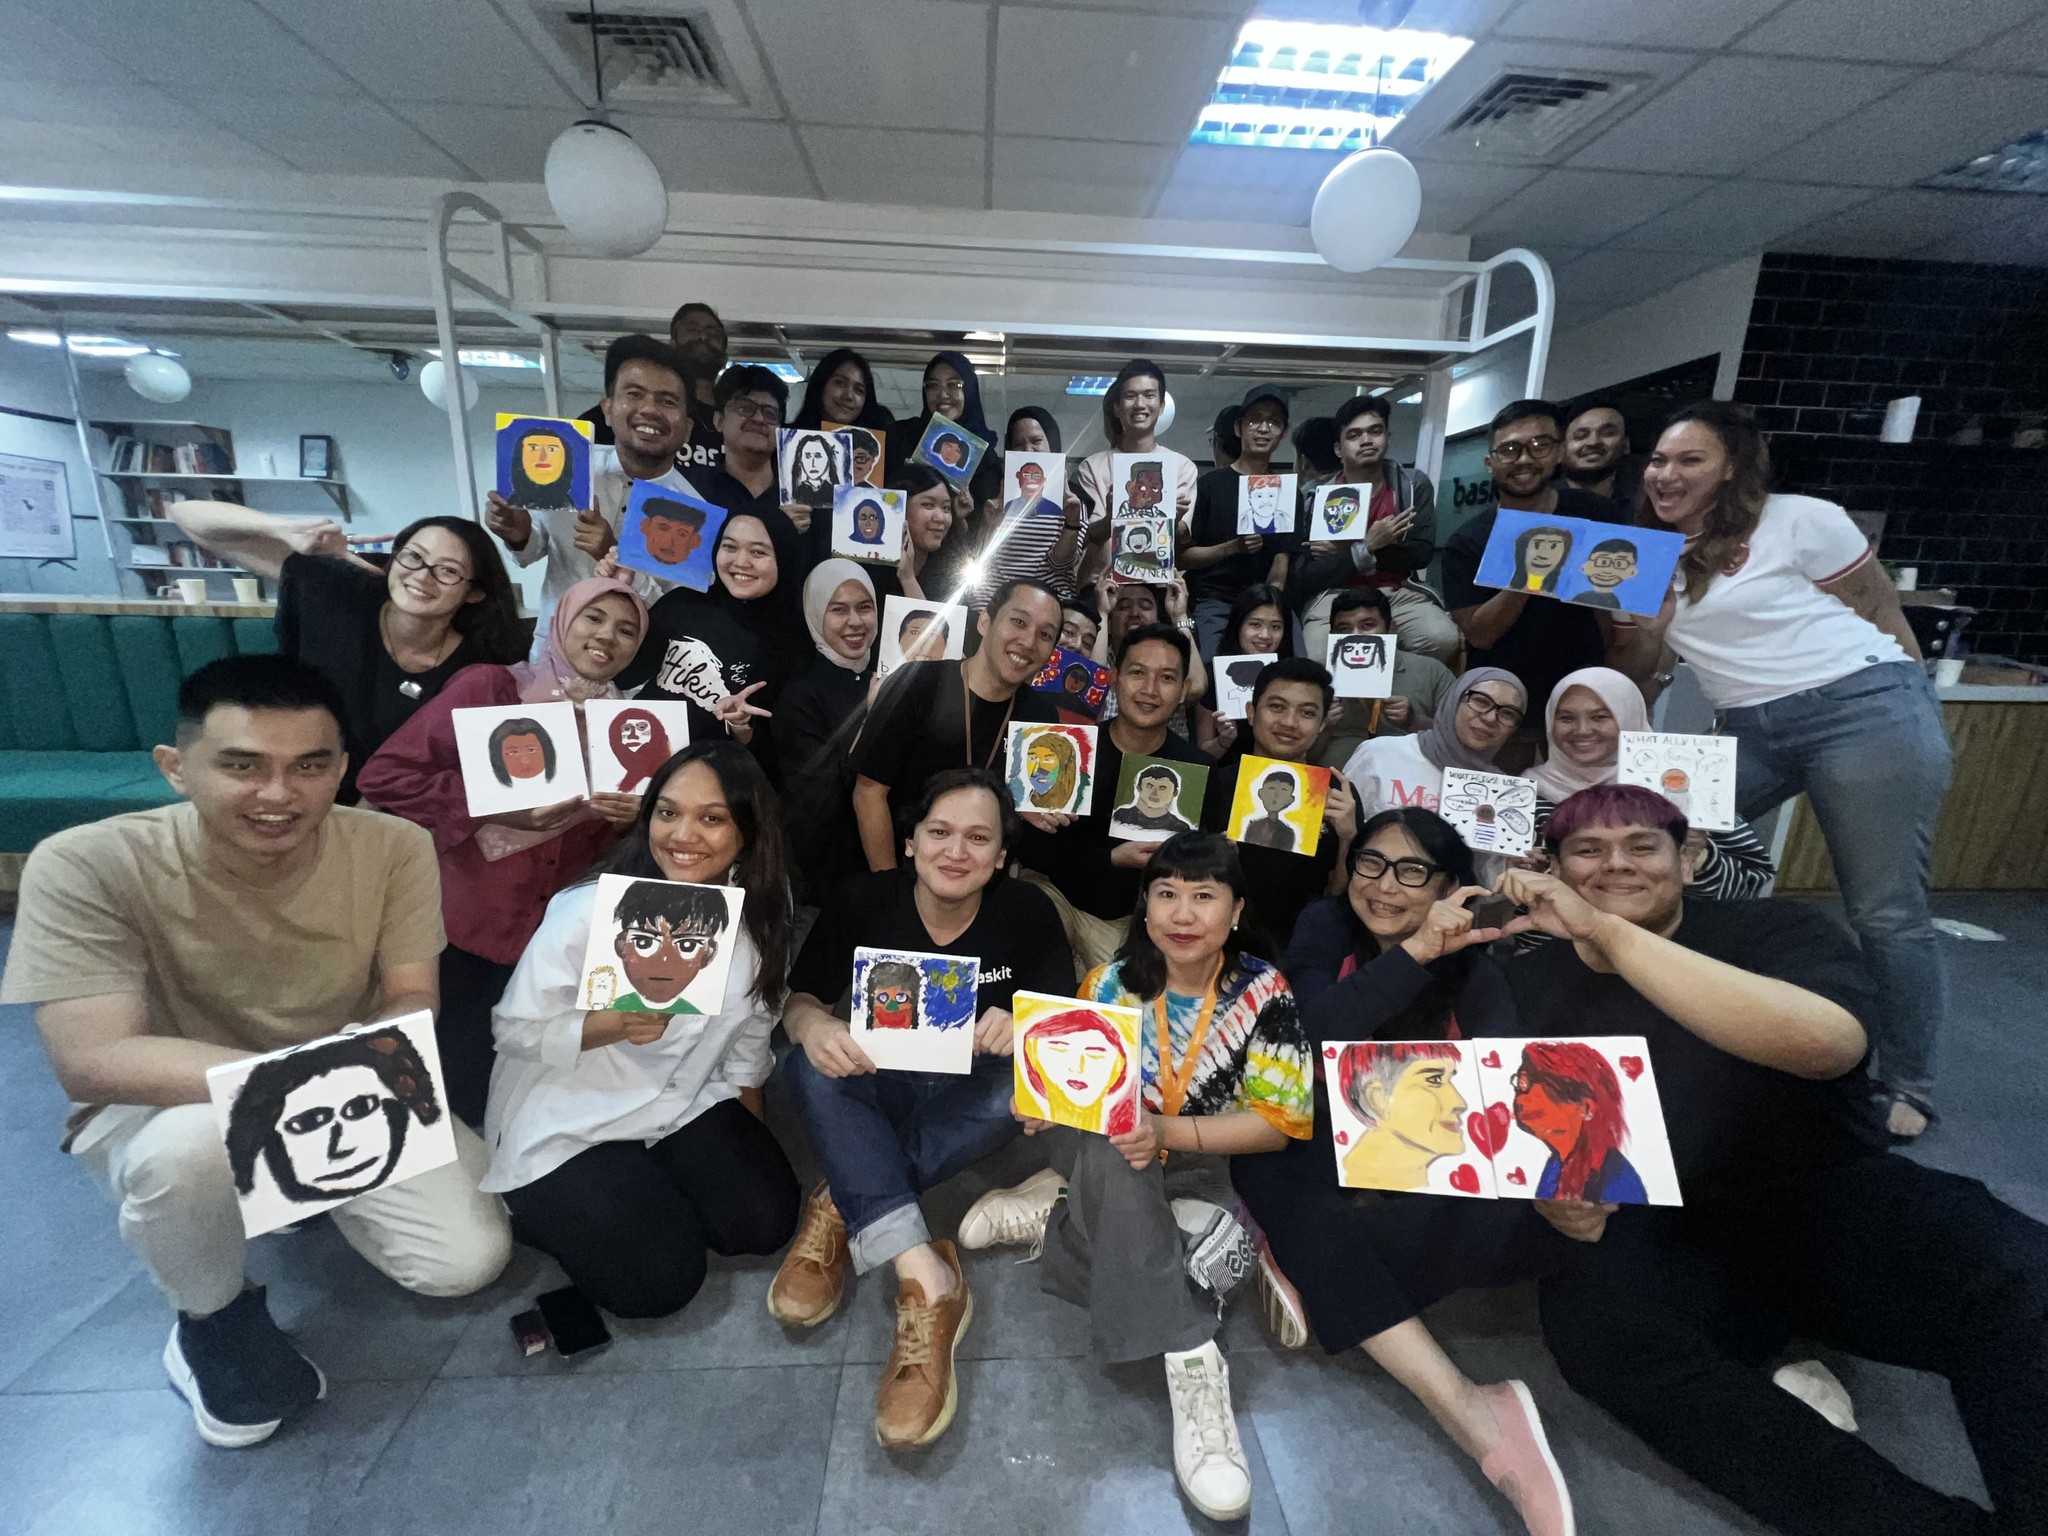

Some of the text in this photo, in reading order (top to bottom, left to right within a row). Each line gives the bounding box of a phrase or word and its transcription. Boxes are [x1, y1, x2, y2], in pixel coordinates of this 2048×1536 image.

[1453, 477, 1495, 507] bas
[663, 644, 721, 705] Hikin
[1623, 735, 1658, 745] WHAT
[1693, 739, 1722, 748] LOVE
[978, 965, 1012, 983] askit
